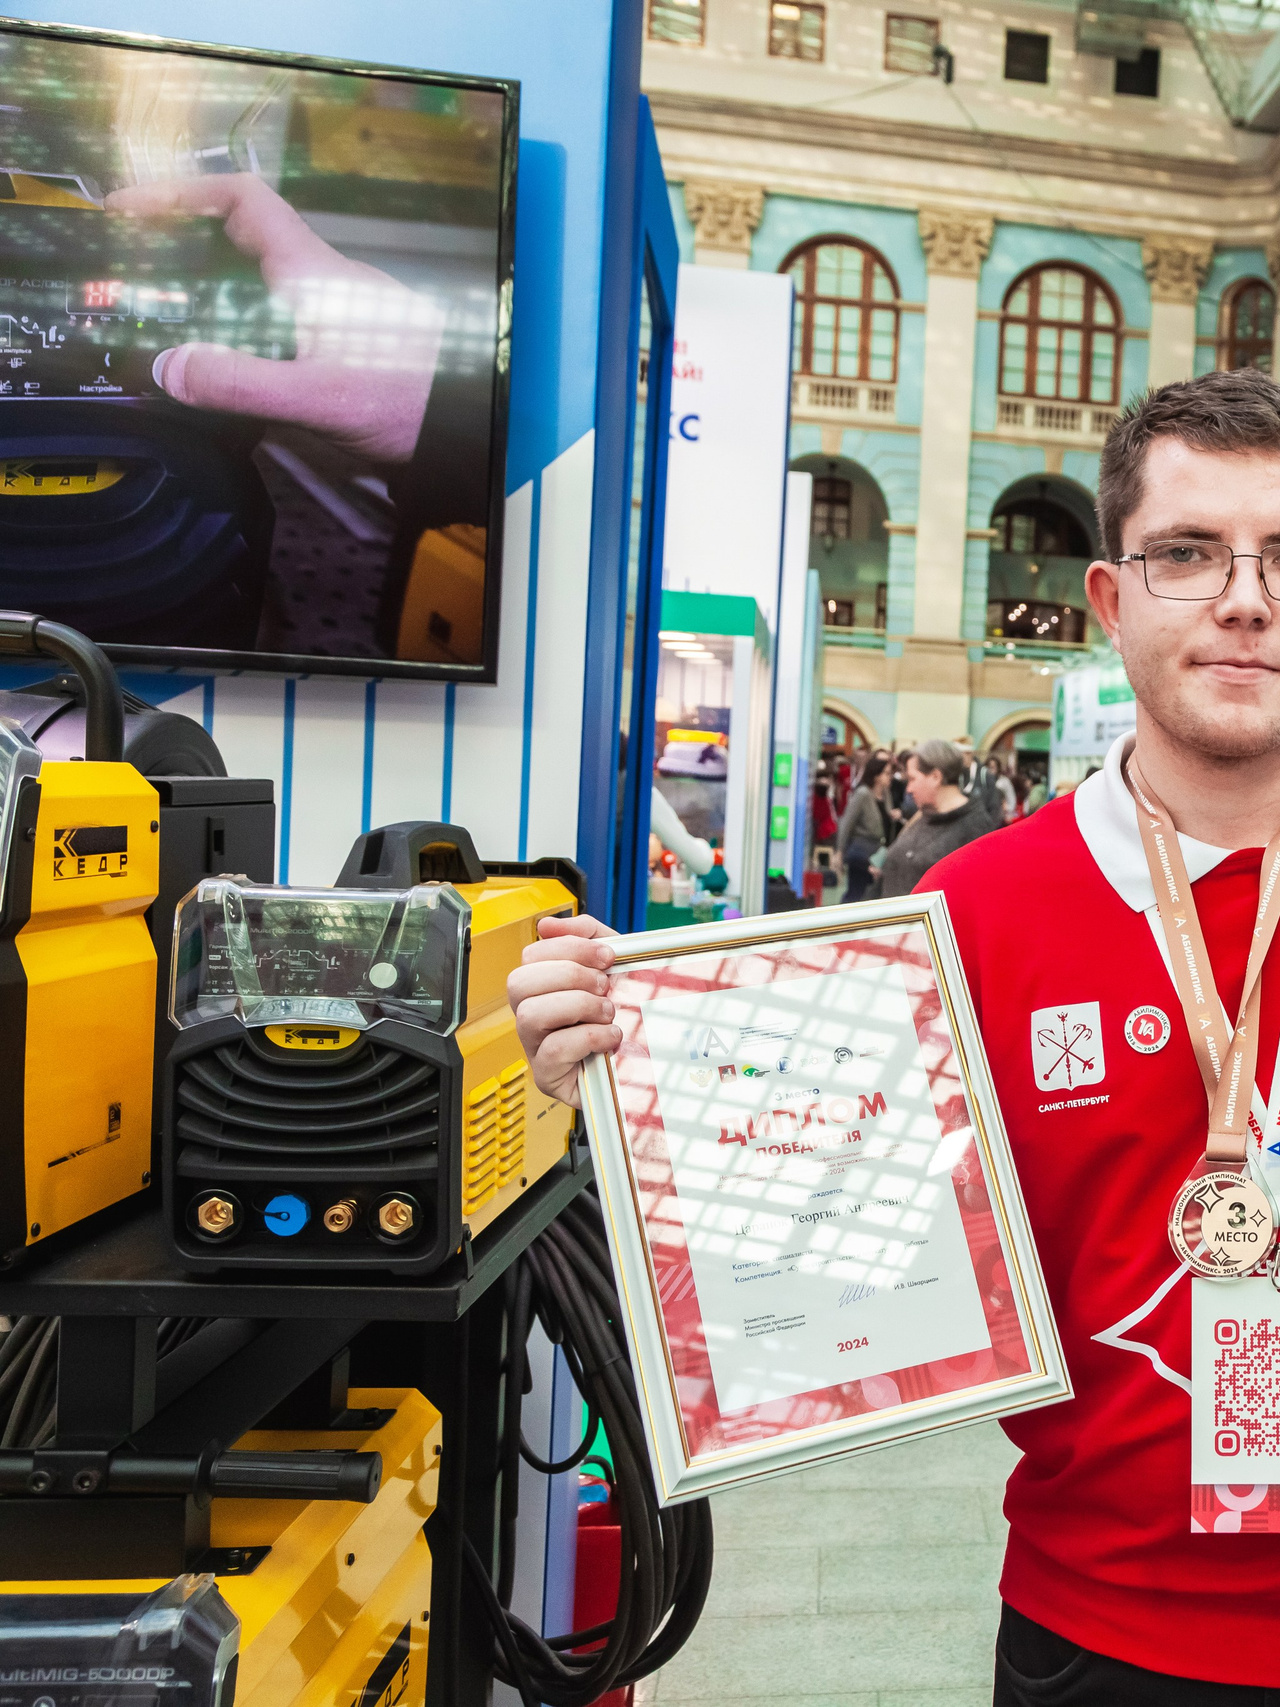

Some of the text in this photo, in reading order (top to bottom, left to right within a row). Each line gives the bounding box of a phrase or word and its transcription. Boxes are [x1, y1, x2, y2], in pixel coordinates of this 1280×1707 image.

[79, 384, 123, 393] Настройка
[53, 854, 128, 877] КЕДР
[1154, 833, 1180, 903] АБИЛИМПИКС
[1180, 933, 1205, 1005] АБИЛИМПИКС
[1224, 1051, 1243, 1128] АБИЛИМПИКС
[1038, 1094, 1111, 1113] САНКТ-ПЕТЕРБУРГ
[717, 1091, 890, 1150] ДИПЛОМ
[755, 1129, 862, 1159] ПОБЕДИТЕЛЯ
[1206, 1173, 1248, 1185] ЧЕМПИОНАТ
[791, 1206, 841, 1225] Георгий
[1227, 1201, 1247, 1229] 3
[1214, 1231, 1259, 1243] МЕСТО
[1223, 1266, 1239, 1275] 2024
[837, 1336, 869, 1353] 2024
